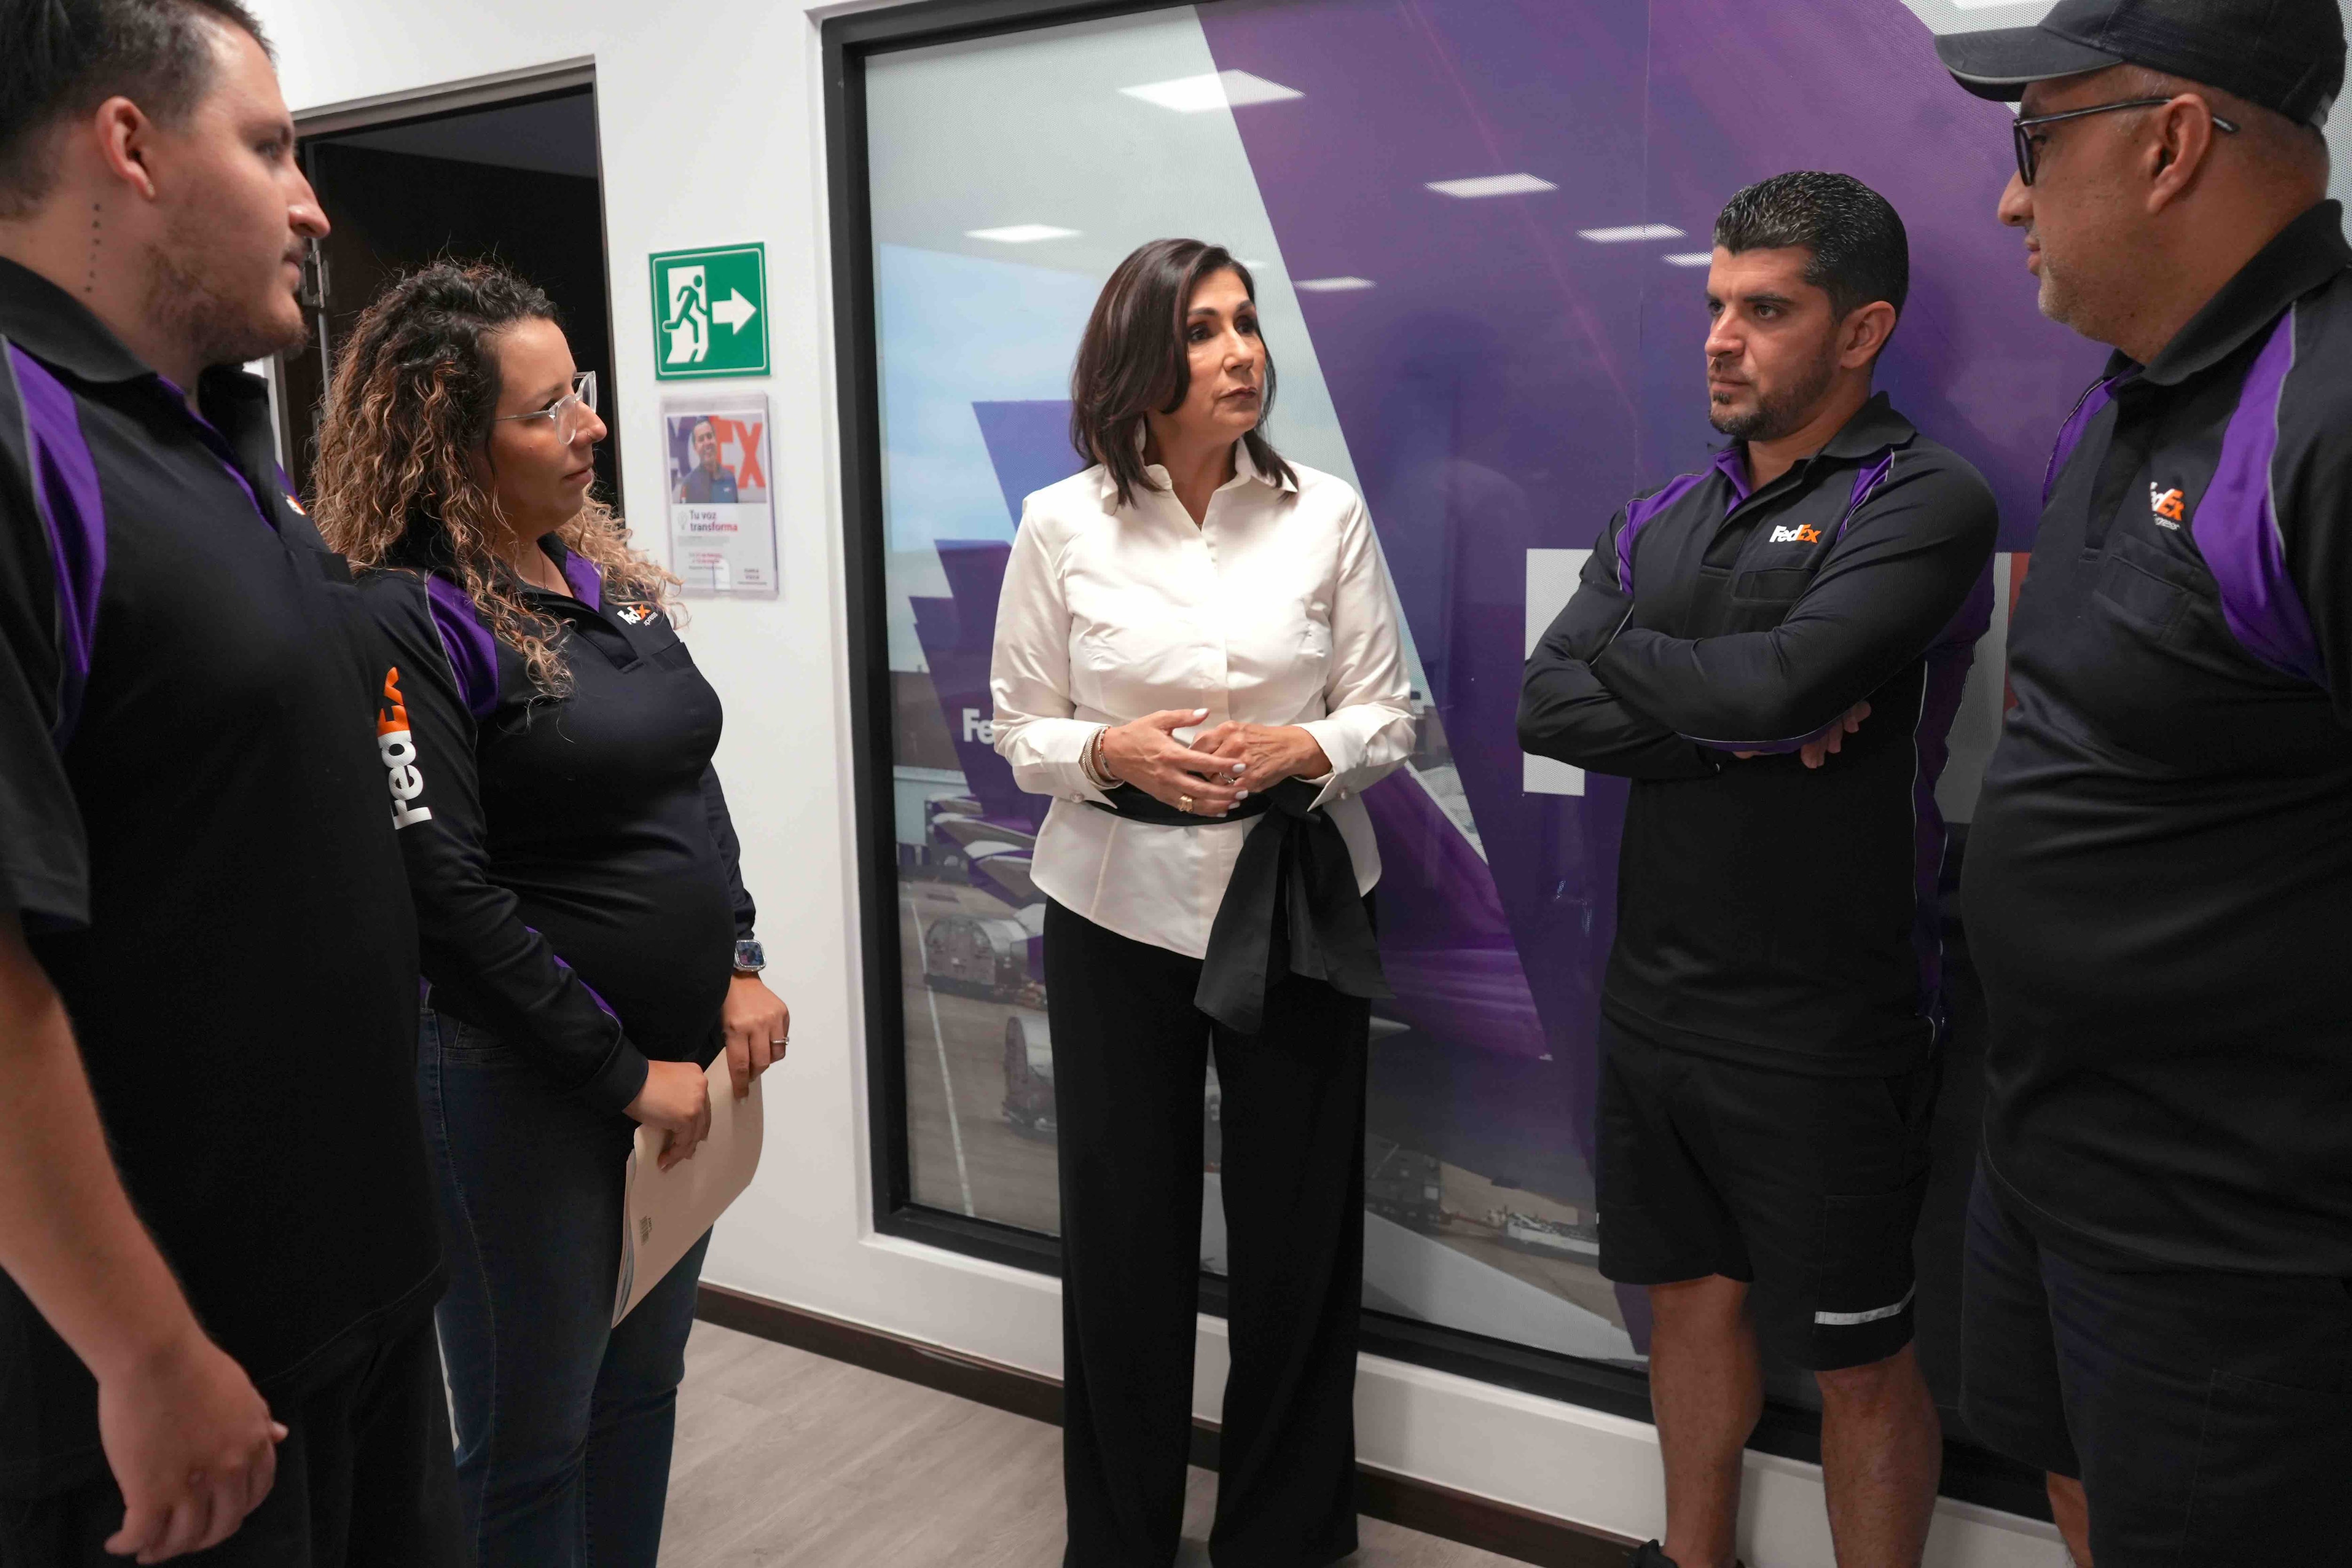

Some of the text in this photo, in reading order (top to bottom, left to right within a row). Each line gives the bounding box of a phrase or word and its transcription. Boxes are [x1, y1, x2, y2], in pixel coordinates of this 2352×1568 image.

[689, 509, 716, 520] Tu voz
[690, 522, 738, 532] transforma
[1769, 524, 1821, 543] FedEx
